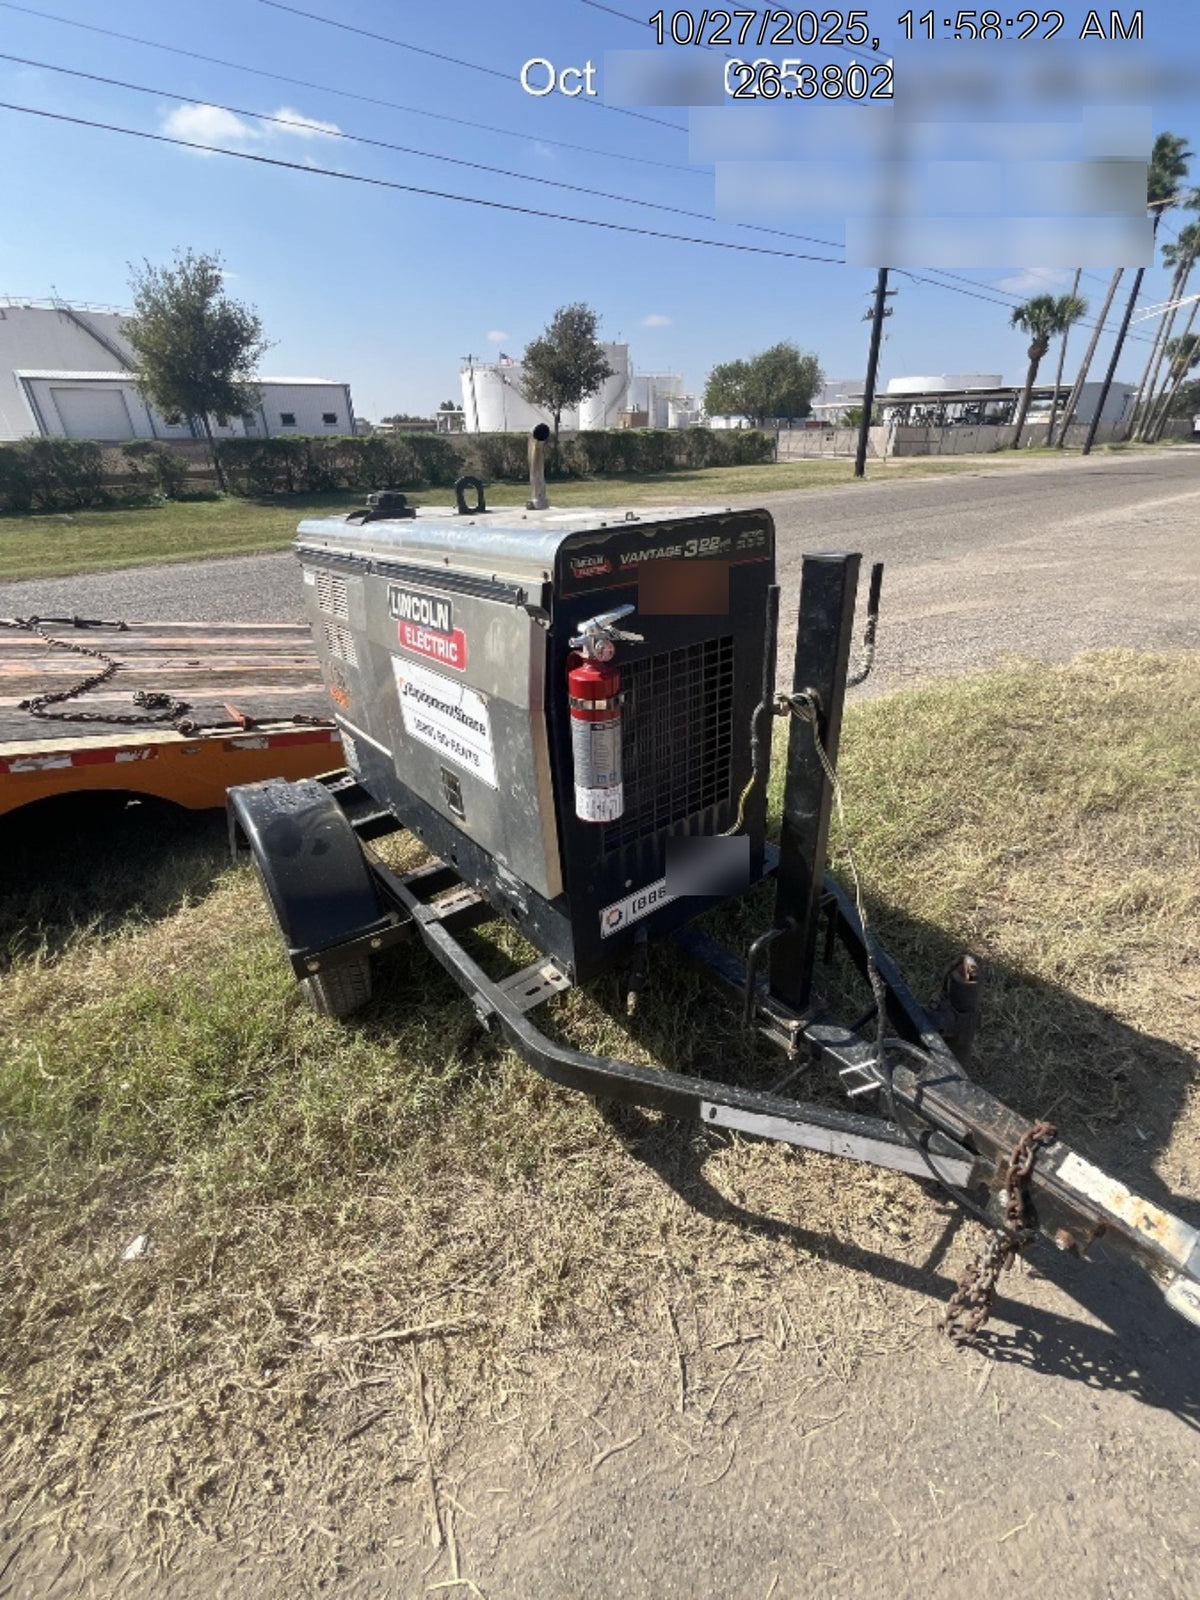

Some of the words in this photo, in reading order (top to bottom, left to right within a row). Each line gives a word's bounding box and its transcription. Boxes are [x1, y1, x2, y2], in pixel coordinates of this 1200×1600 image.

[620, 545, 682, 564] VANTAGE
[390, 592, 449, 630] LINCOLN
[405, 627, 459, 661] ELECTRIC
